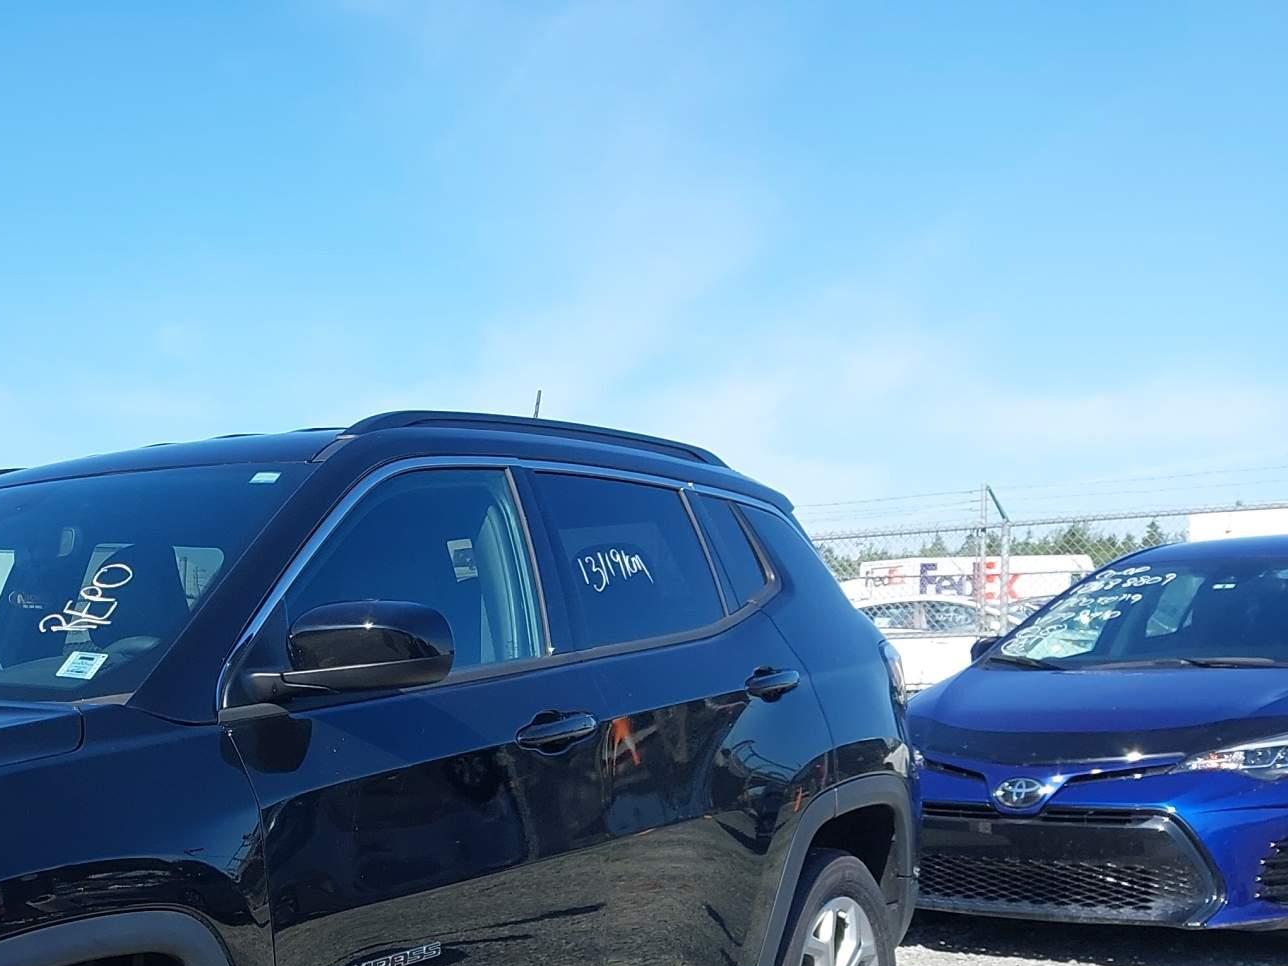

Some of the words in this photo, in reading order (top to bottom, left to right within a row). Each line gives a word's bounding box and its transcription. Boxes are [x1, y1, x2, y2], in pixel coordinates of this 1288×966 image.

[864, 567, 906, 588] FedE
[919, 562, 1018, 601] FedEx
[38, 563, 133, 633] REPO
